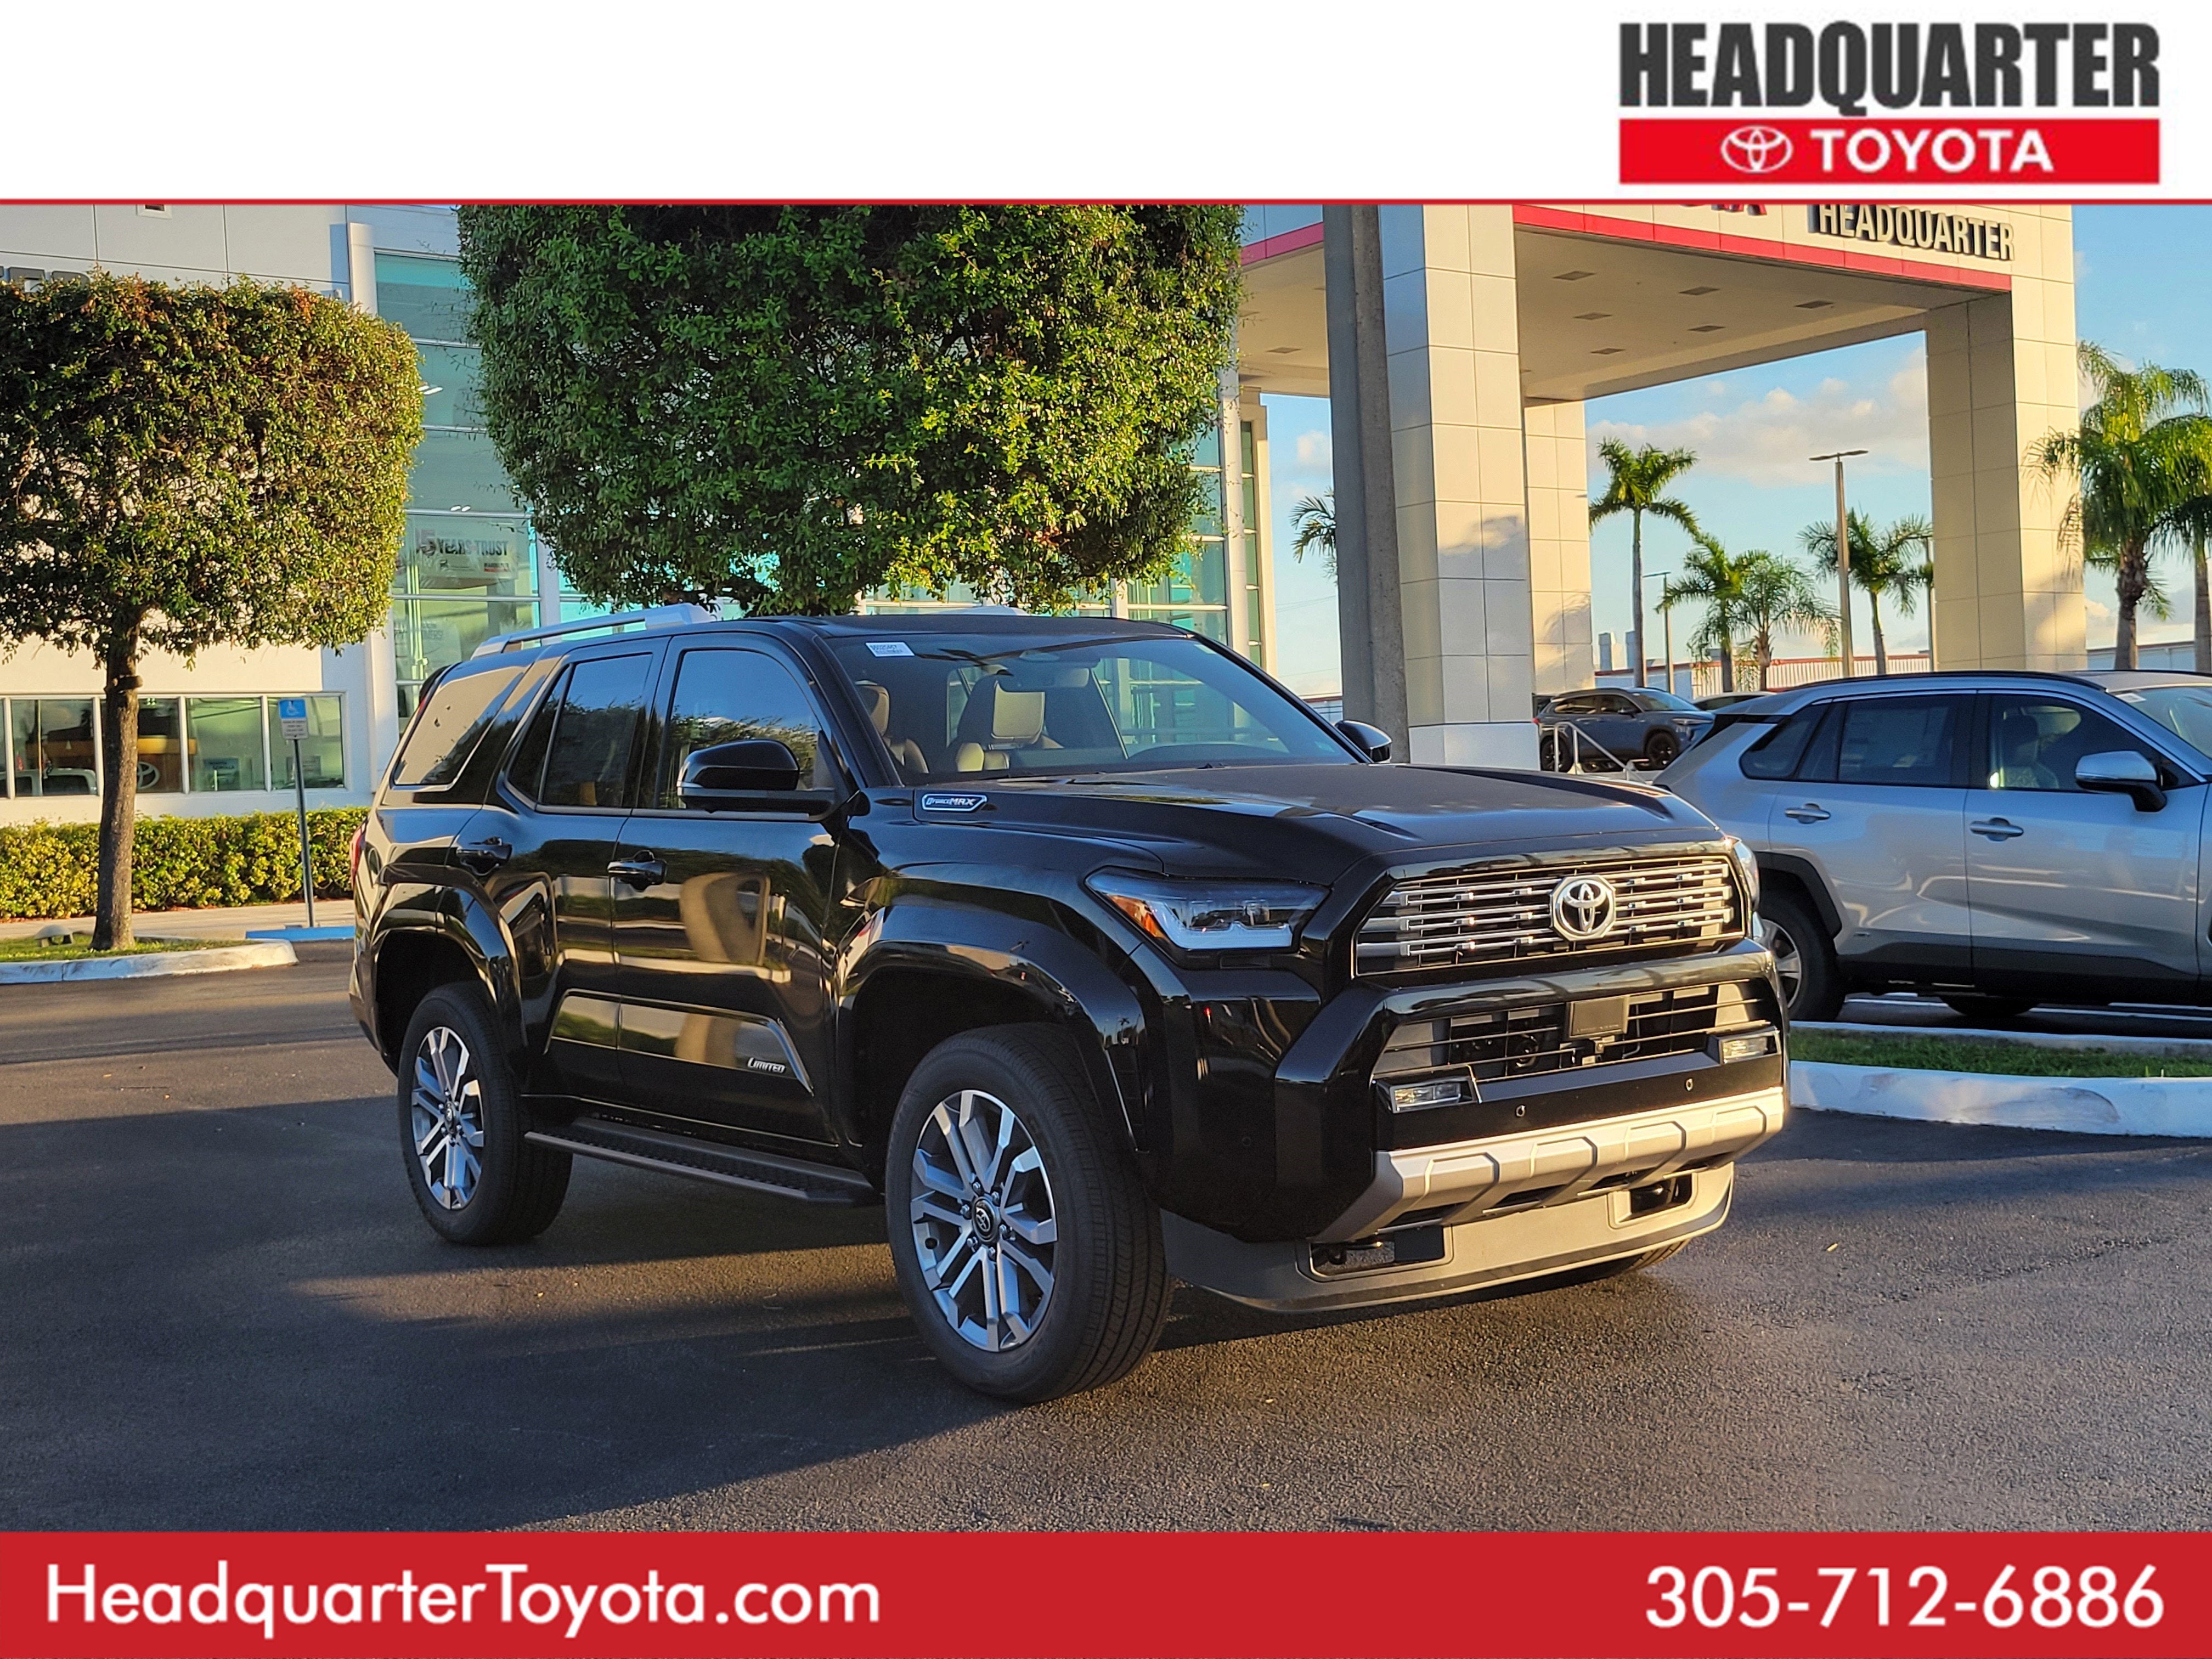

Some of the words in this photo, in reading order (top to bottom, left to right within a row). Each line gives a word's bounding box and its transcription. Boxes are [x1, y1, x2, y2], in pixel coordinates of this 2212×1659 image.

[1817, 204, 2015, 261] HEADQUARTER
[437, 538, 472, 555] YEARS
[474, 540, 508, 556] TRUST
[747, 1057, 786, 1073] LIMITED
